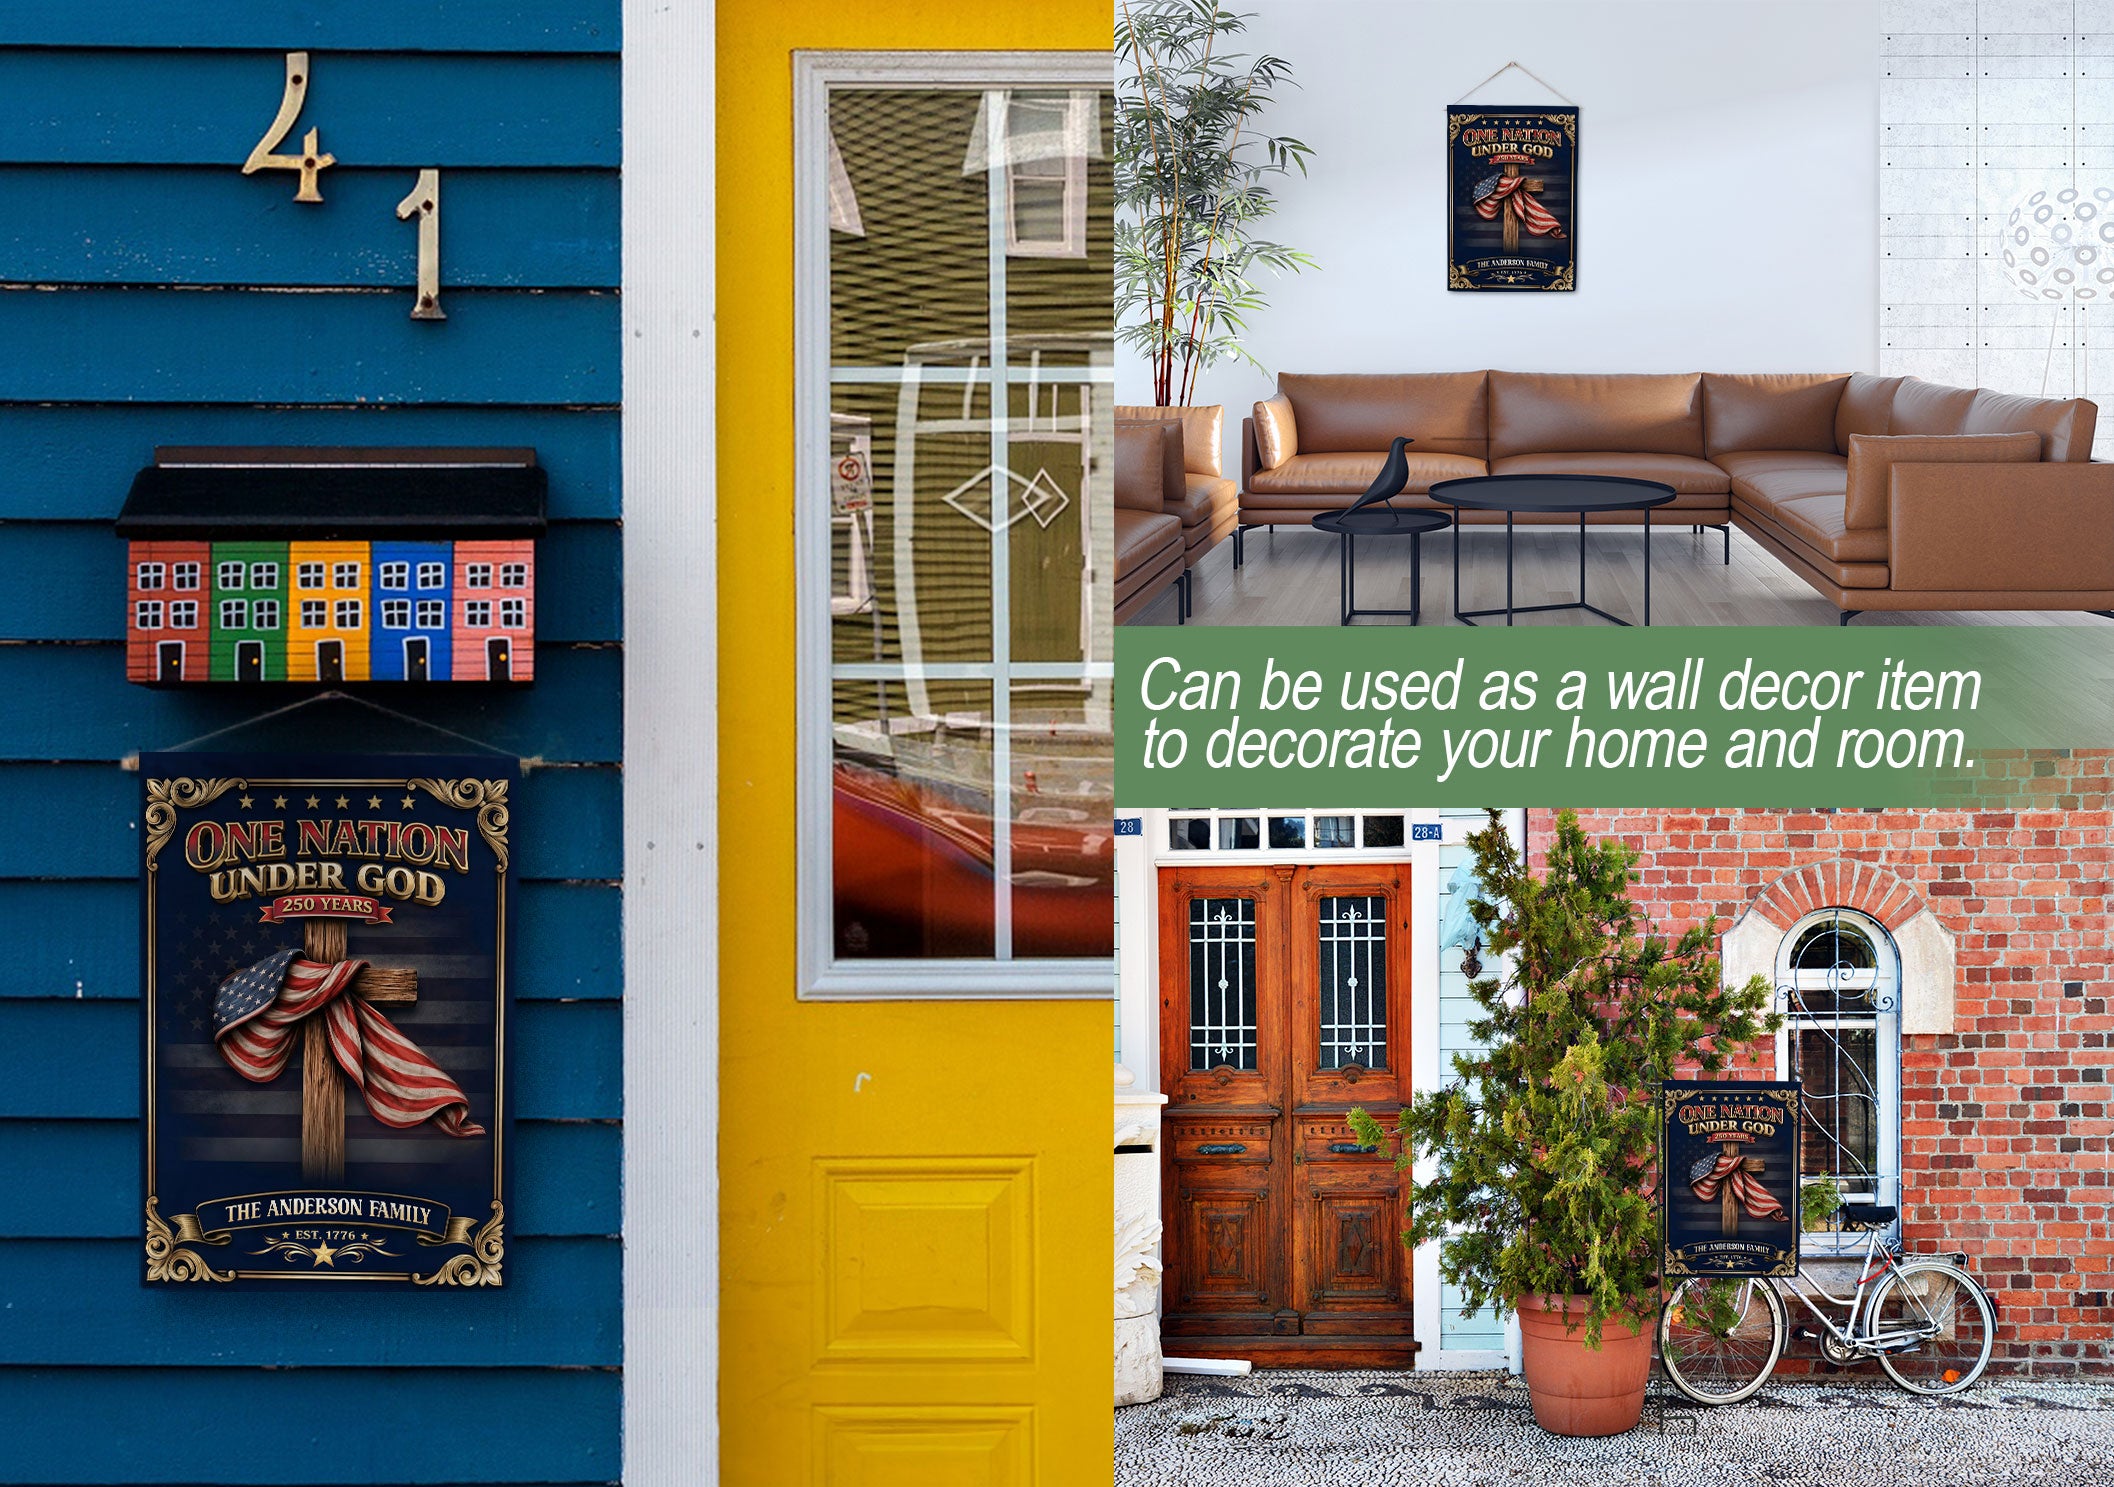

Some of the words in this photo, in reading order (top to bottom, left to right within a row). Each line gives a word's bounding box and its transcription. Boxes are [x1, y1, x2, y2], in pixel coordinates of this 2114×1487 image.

[1463, 128, 1498, 147] ONE
[1502, 128, 1562, 147] NATION
[1472, 143, 1520, 157] UNDER
[1522, 143, 1553, 159] GOD
[1120, 821, 1134, 833] 28
[1414, 826, 1440, 839] 28-A
[185, 820, 288, 872] ONE
[297, 820, 470, 873] NATION
[209, 862, 349, 904] UNDER
[357, 863, 446, 906] GOD
[282, 897, 315, 914] 250
[320, 897, 373, 914] YEARS
[1679, 1105, 1717, 1124] ONE
[1720, 1104, 1784, 1125] NATION
[1688, 1120, 1739, 1135] UNDER
[1742, 1120, 1775, 1137] GOD
[225, 1200, 262, 1223] THE
[266, 1197, 363, 1217] ANDERSON
[369, 1200, 431, 1226] FAMILY
[295, 1230, 322, 1241] EST.
[326, 1230, 355, 1242] 1776
[1709, 1243, 1745, 1251] ANDERSON
[1746, 1243, 1770, 1254] FAMILY
